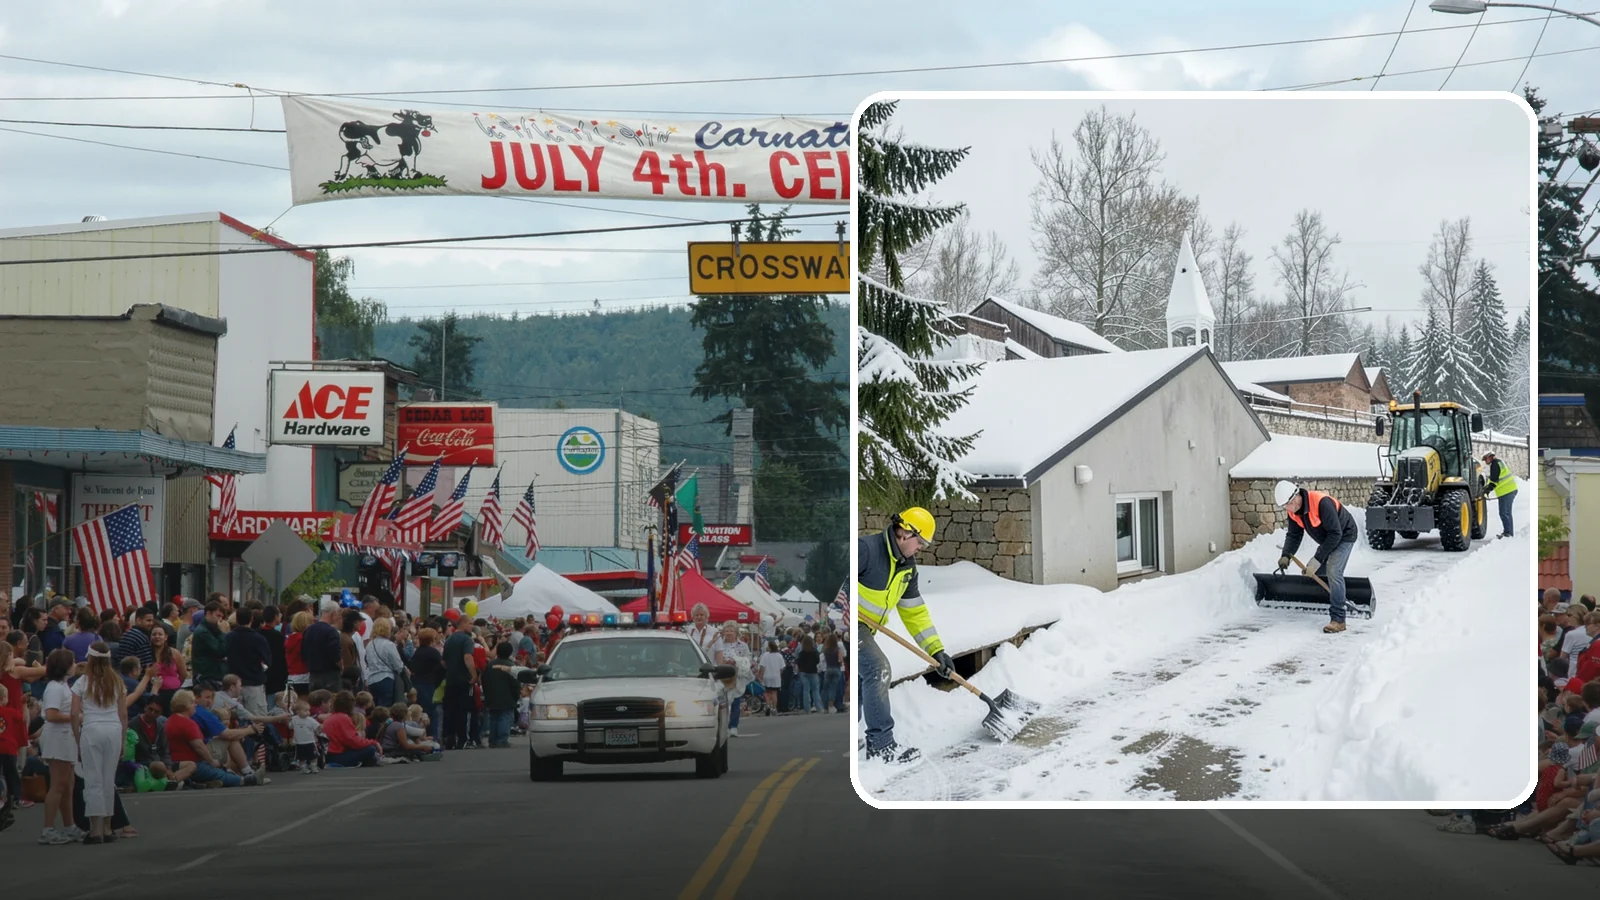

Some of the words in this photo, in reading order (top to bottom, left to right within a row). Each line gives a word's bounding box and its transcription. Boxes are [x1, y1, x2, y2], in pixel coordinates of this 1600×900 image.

[481, 141, 605, 192] JULY
[632, 150, 746, 197] 4th.
[697, 254, 850, 279] CROSSWA
[282, 380, 373, 419] ACE
[405, 409, 452, 422] CEDAR
[461, 409, 485, 421] LOG
[283, 421, 371, 436] Hardware
[416, 428, 477, 447] Coca-Cola
[95, 485, 124, 494] Vincent
[126, 486, 136, 494] de
[137, 486, 155, 495] Paul
[212, 516, 331, 535] HARDARE
[688, 526, 741, 535] CRNATION
[699, 535, 730, 543] GLASS
